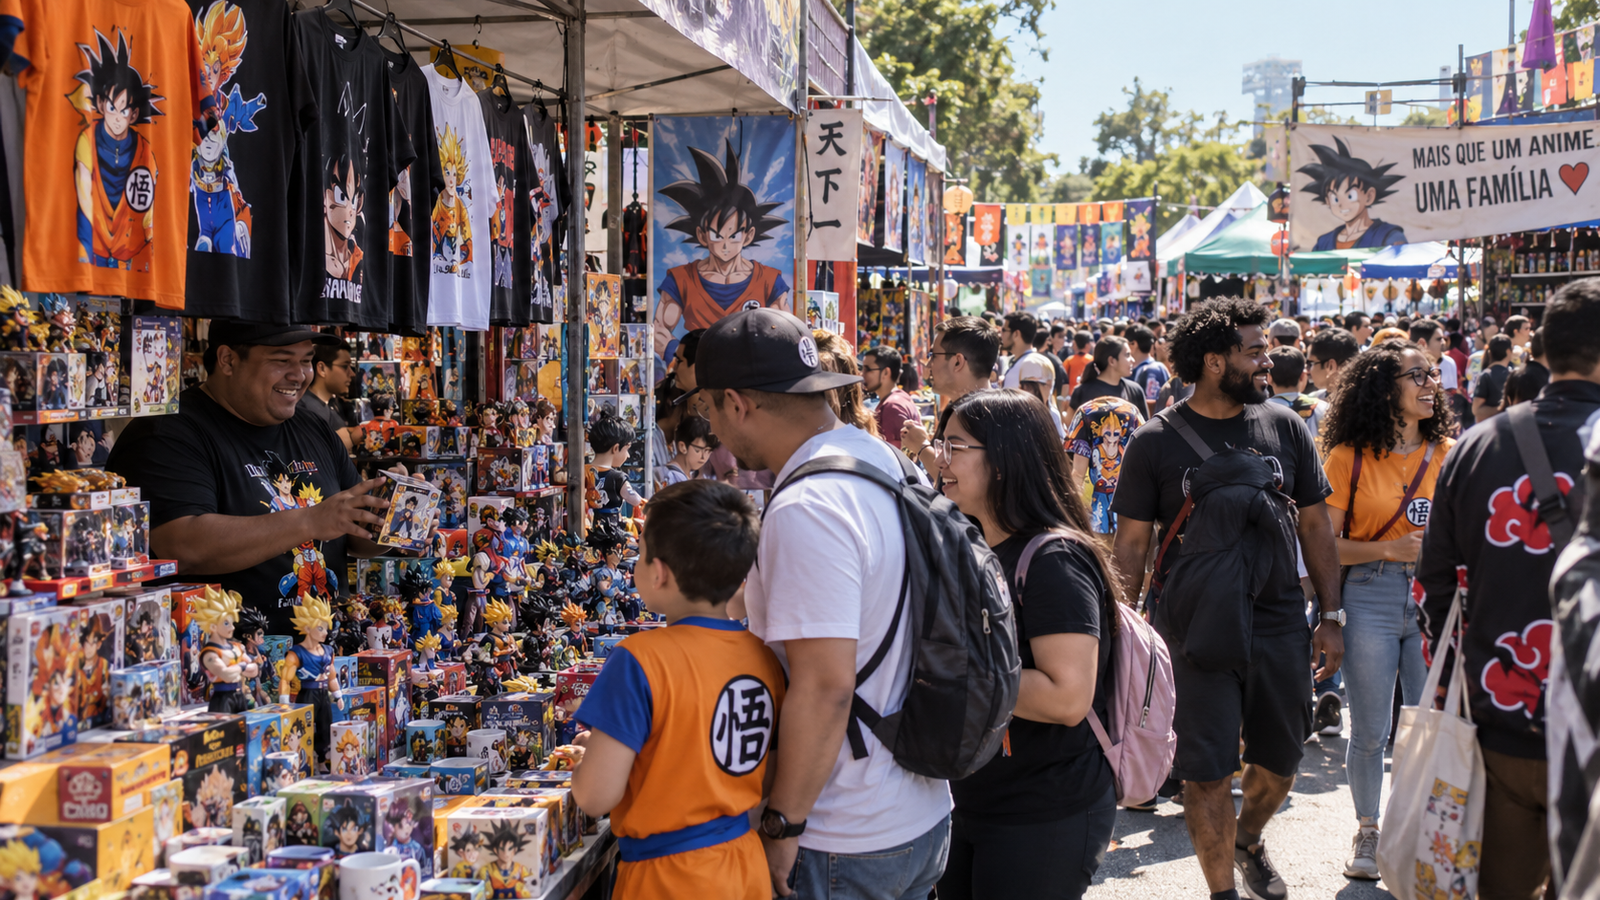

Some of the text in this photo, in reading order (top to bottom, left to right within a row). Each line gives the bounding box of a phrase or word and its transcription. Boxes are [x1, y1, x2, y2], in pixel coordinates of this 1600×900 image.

[814, 120, 847, 229] 天下一
[1412, 144, 1451, 169] MAIS
[1456, 141, 1486, 166] QUE
[1492, 138, 1522, 160] UM
[1415, 165, 1554, 213] UMA FAMÍLIA
[1409, 501, 1429, 523] 悟
[716, 686, 770, 768] 悟
